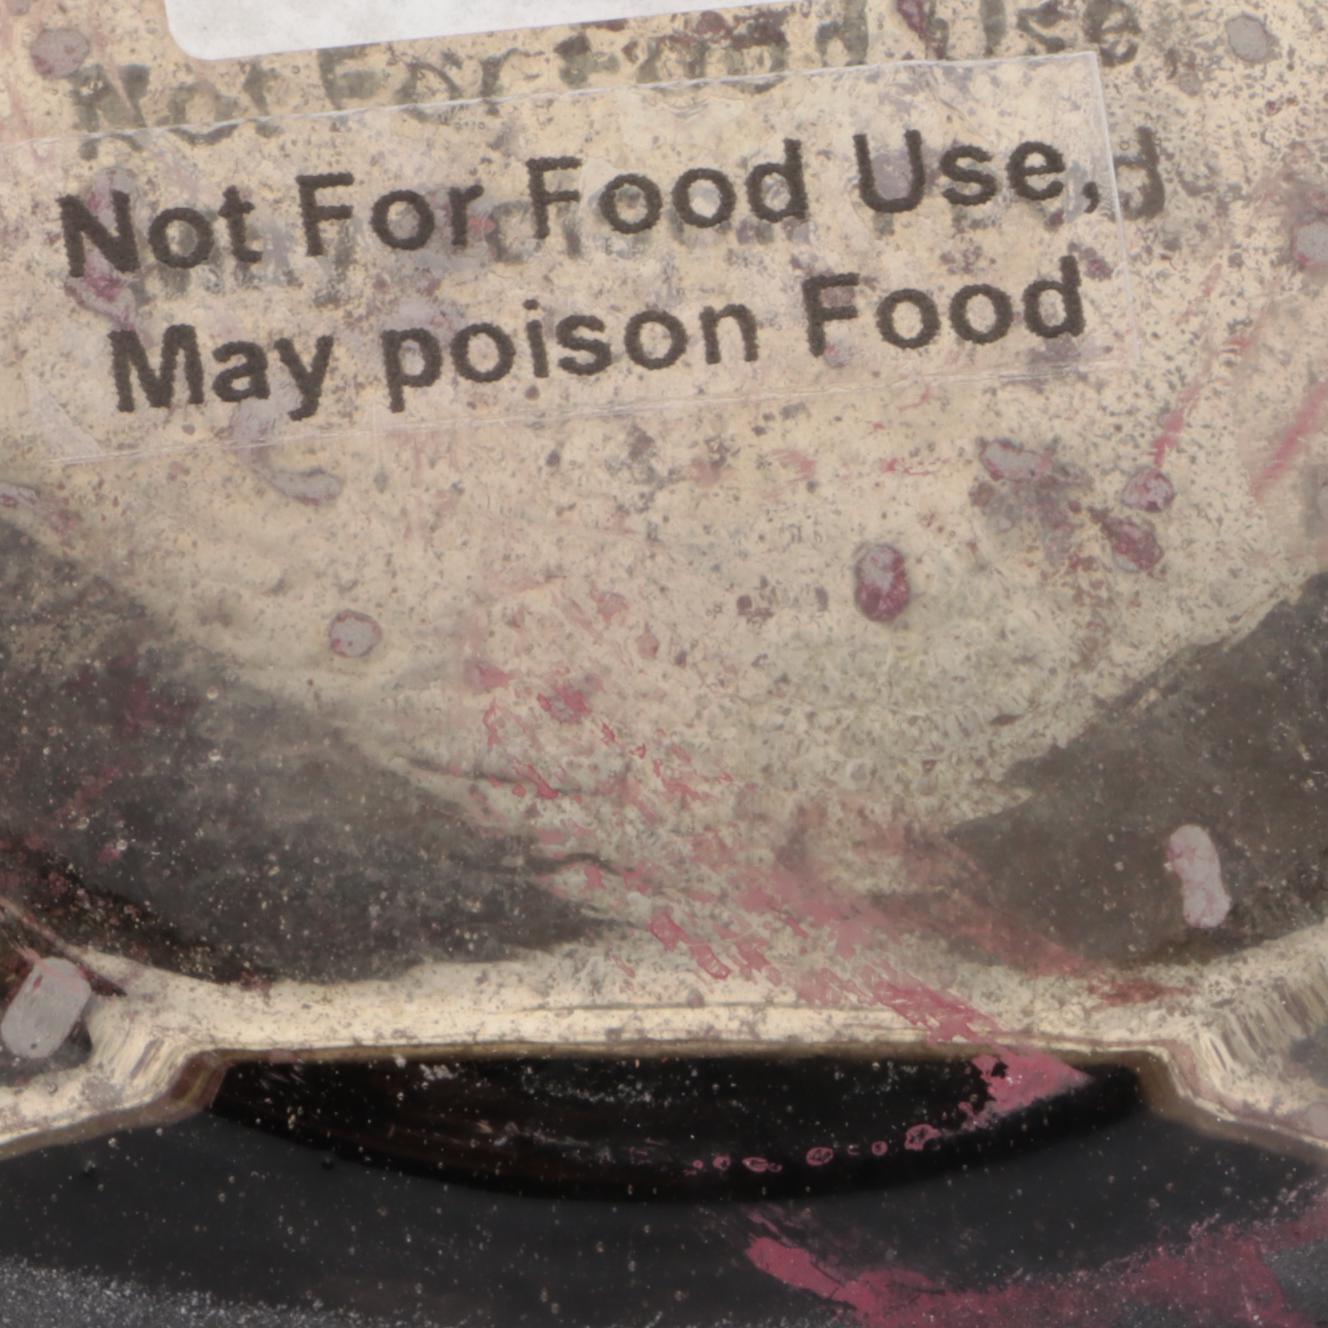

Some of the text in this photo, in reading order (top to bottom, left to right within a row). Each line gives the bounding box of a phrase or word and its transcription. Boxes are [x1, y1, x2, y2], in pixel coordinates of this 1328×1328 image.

[57, 128, 1104, 274] Not For Food Use,
[108, 255, 1088, 422] May poison Food
